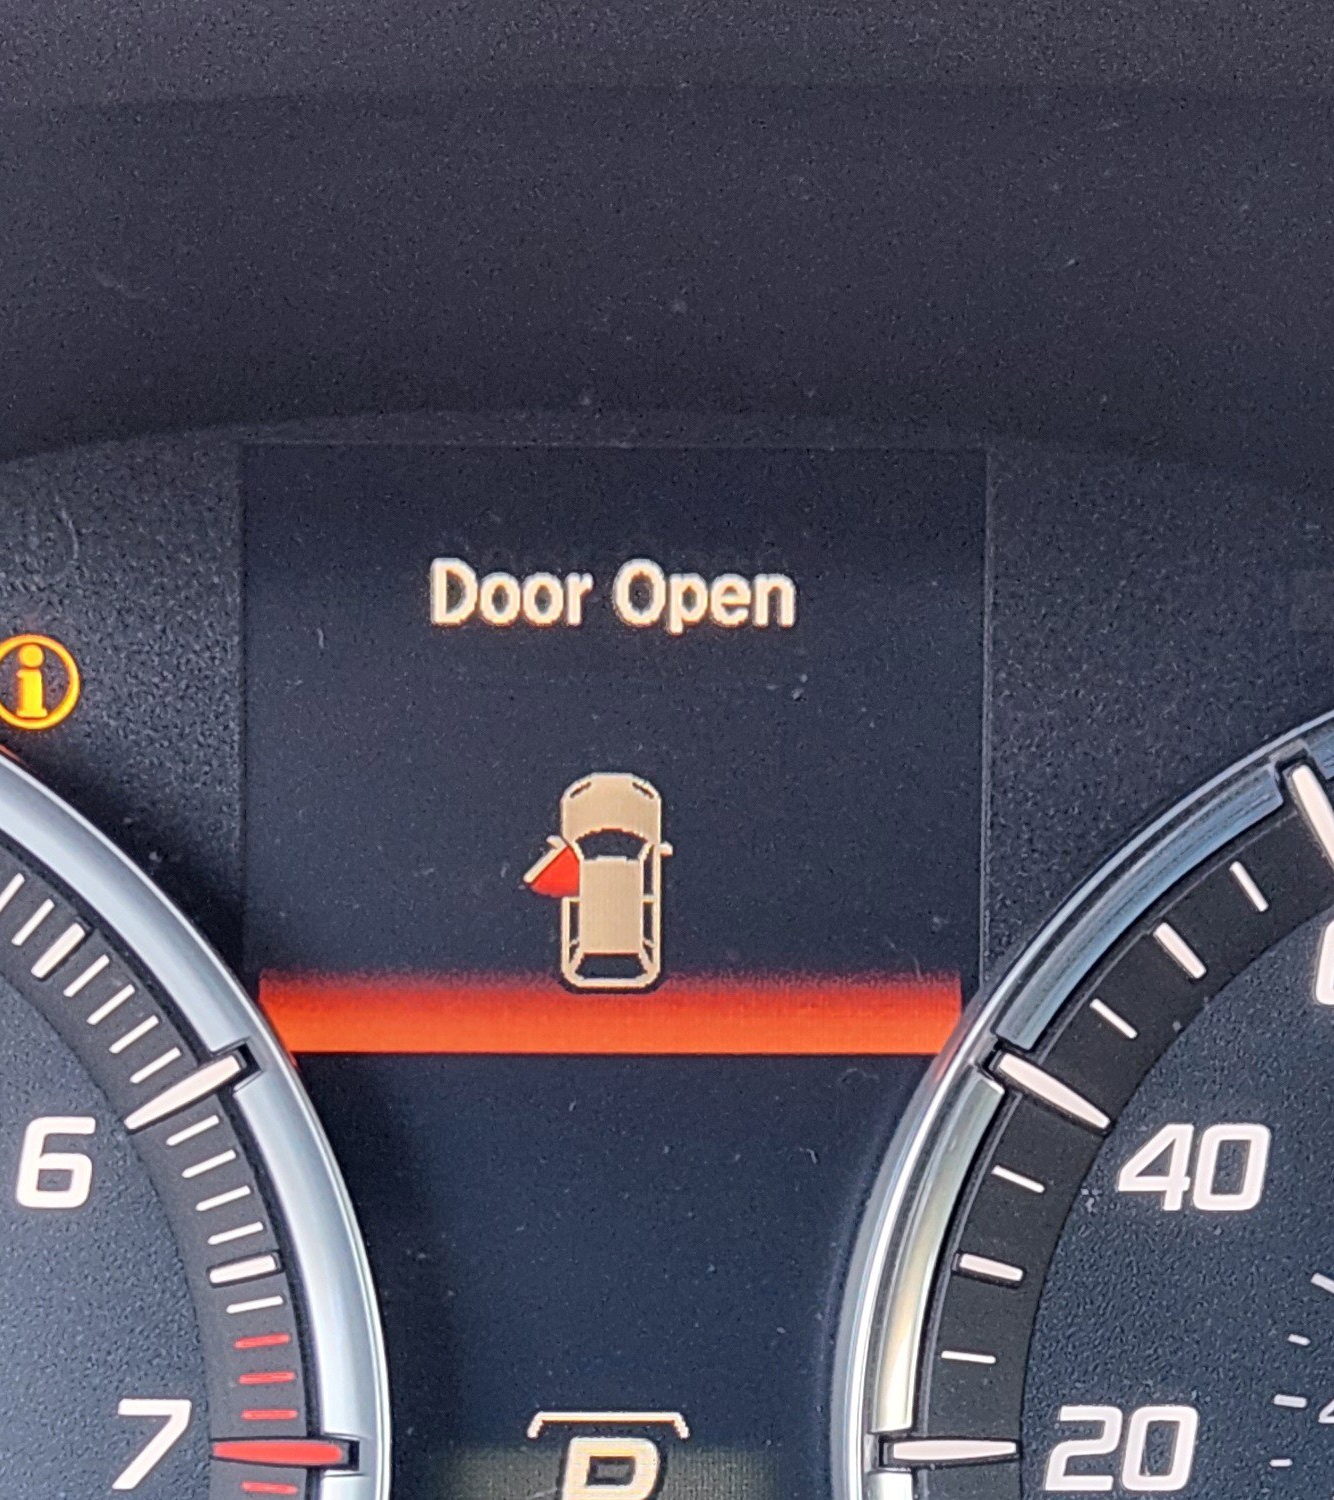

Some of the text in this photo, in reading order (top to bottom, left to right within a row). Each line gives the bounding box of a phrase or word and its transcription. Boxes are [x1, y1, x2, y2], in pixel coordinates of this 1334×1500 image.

[429, 556, 796, 635] Door Open
[14, 1115, 97, 1210] 6
[1117, 1121, 1272, 1212] 40
[111, 1397, 193, 1491] 7
[1043, 1403, 1200, 1493] 20
